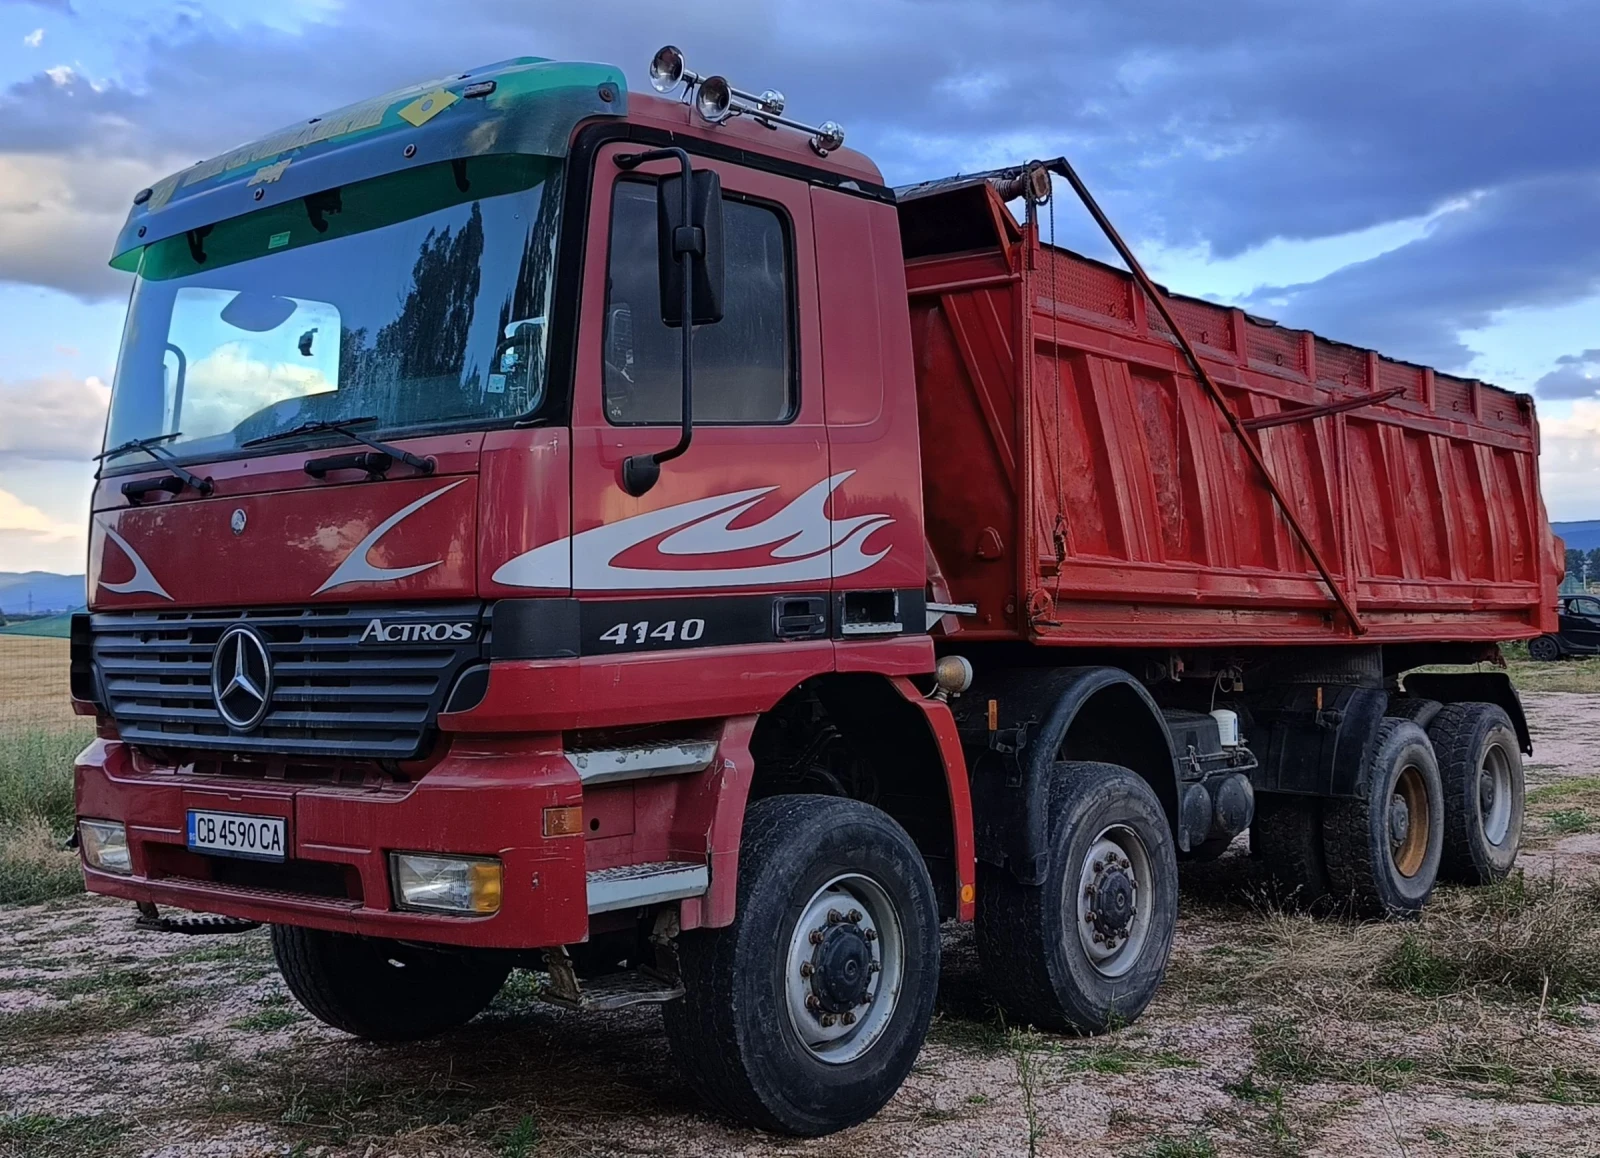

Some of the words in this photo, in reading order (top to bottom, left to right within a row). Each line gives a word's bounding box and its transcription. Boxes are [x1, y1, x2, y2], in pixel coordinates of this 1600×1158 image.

[599, 618, 706, 645] 4140
[197, 817, 217, 844] CB
[219, 819, 257, 848] 4590
[260, 823, 281, 851] CA
